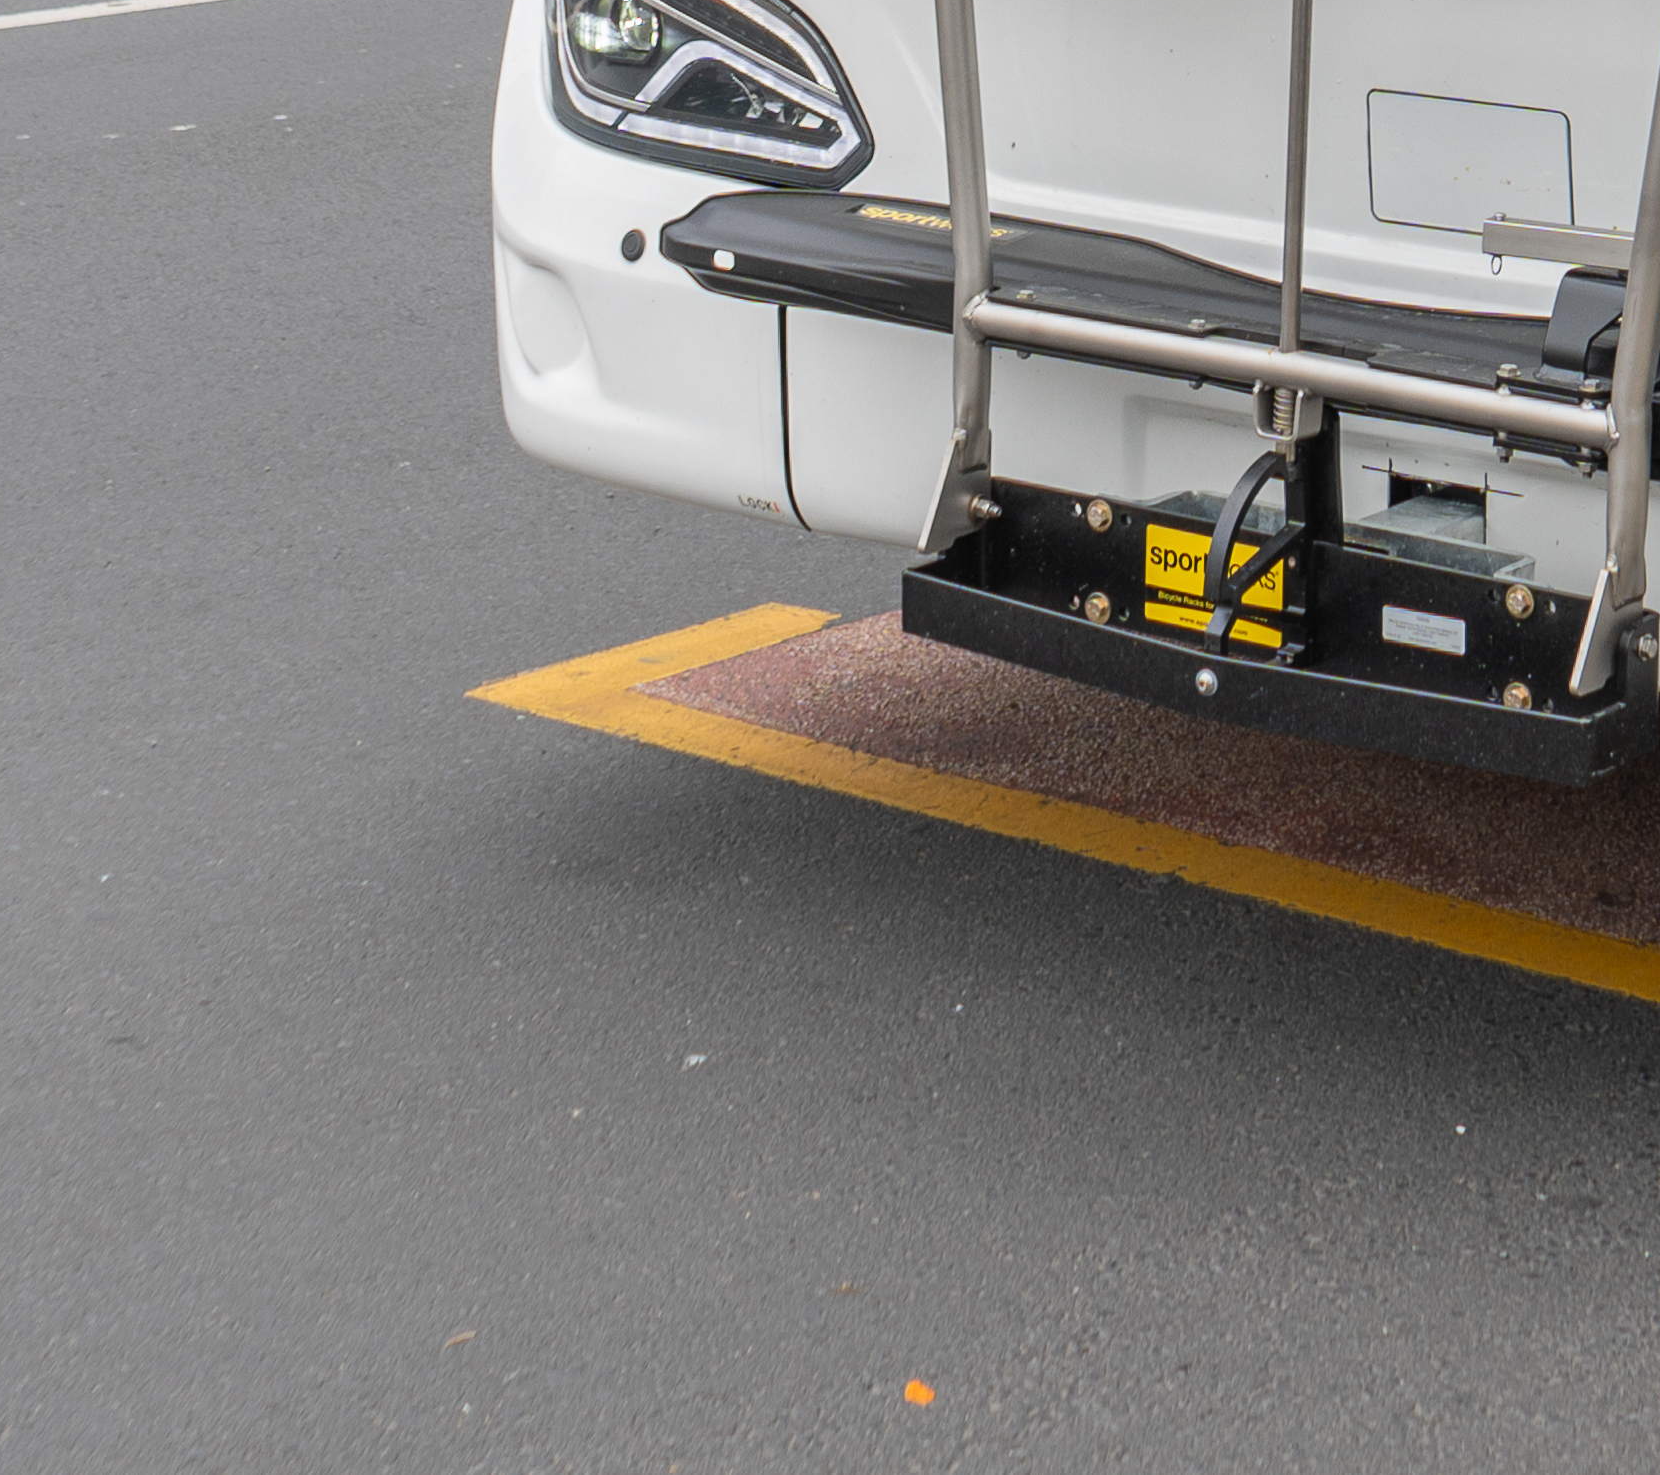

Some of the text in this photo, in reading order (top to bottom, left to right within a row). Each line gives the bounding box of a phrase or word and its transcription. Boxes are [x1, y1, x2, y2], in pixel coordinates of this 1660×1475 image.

[1158, 590, 1215, 610] Bicycle Racks for
